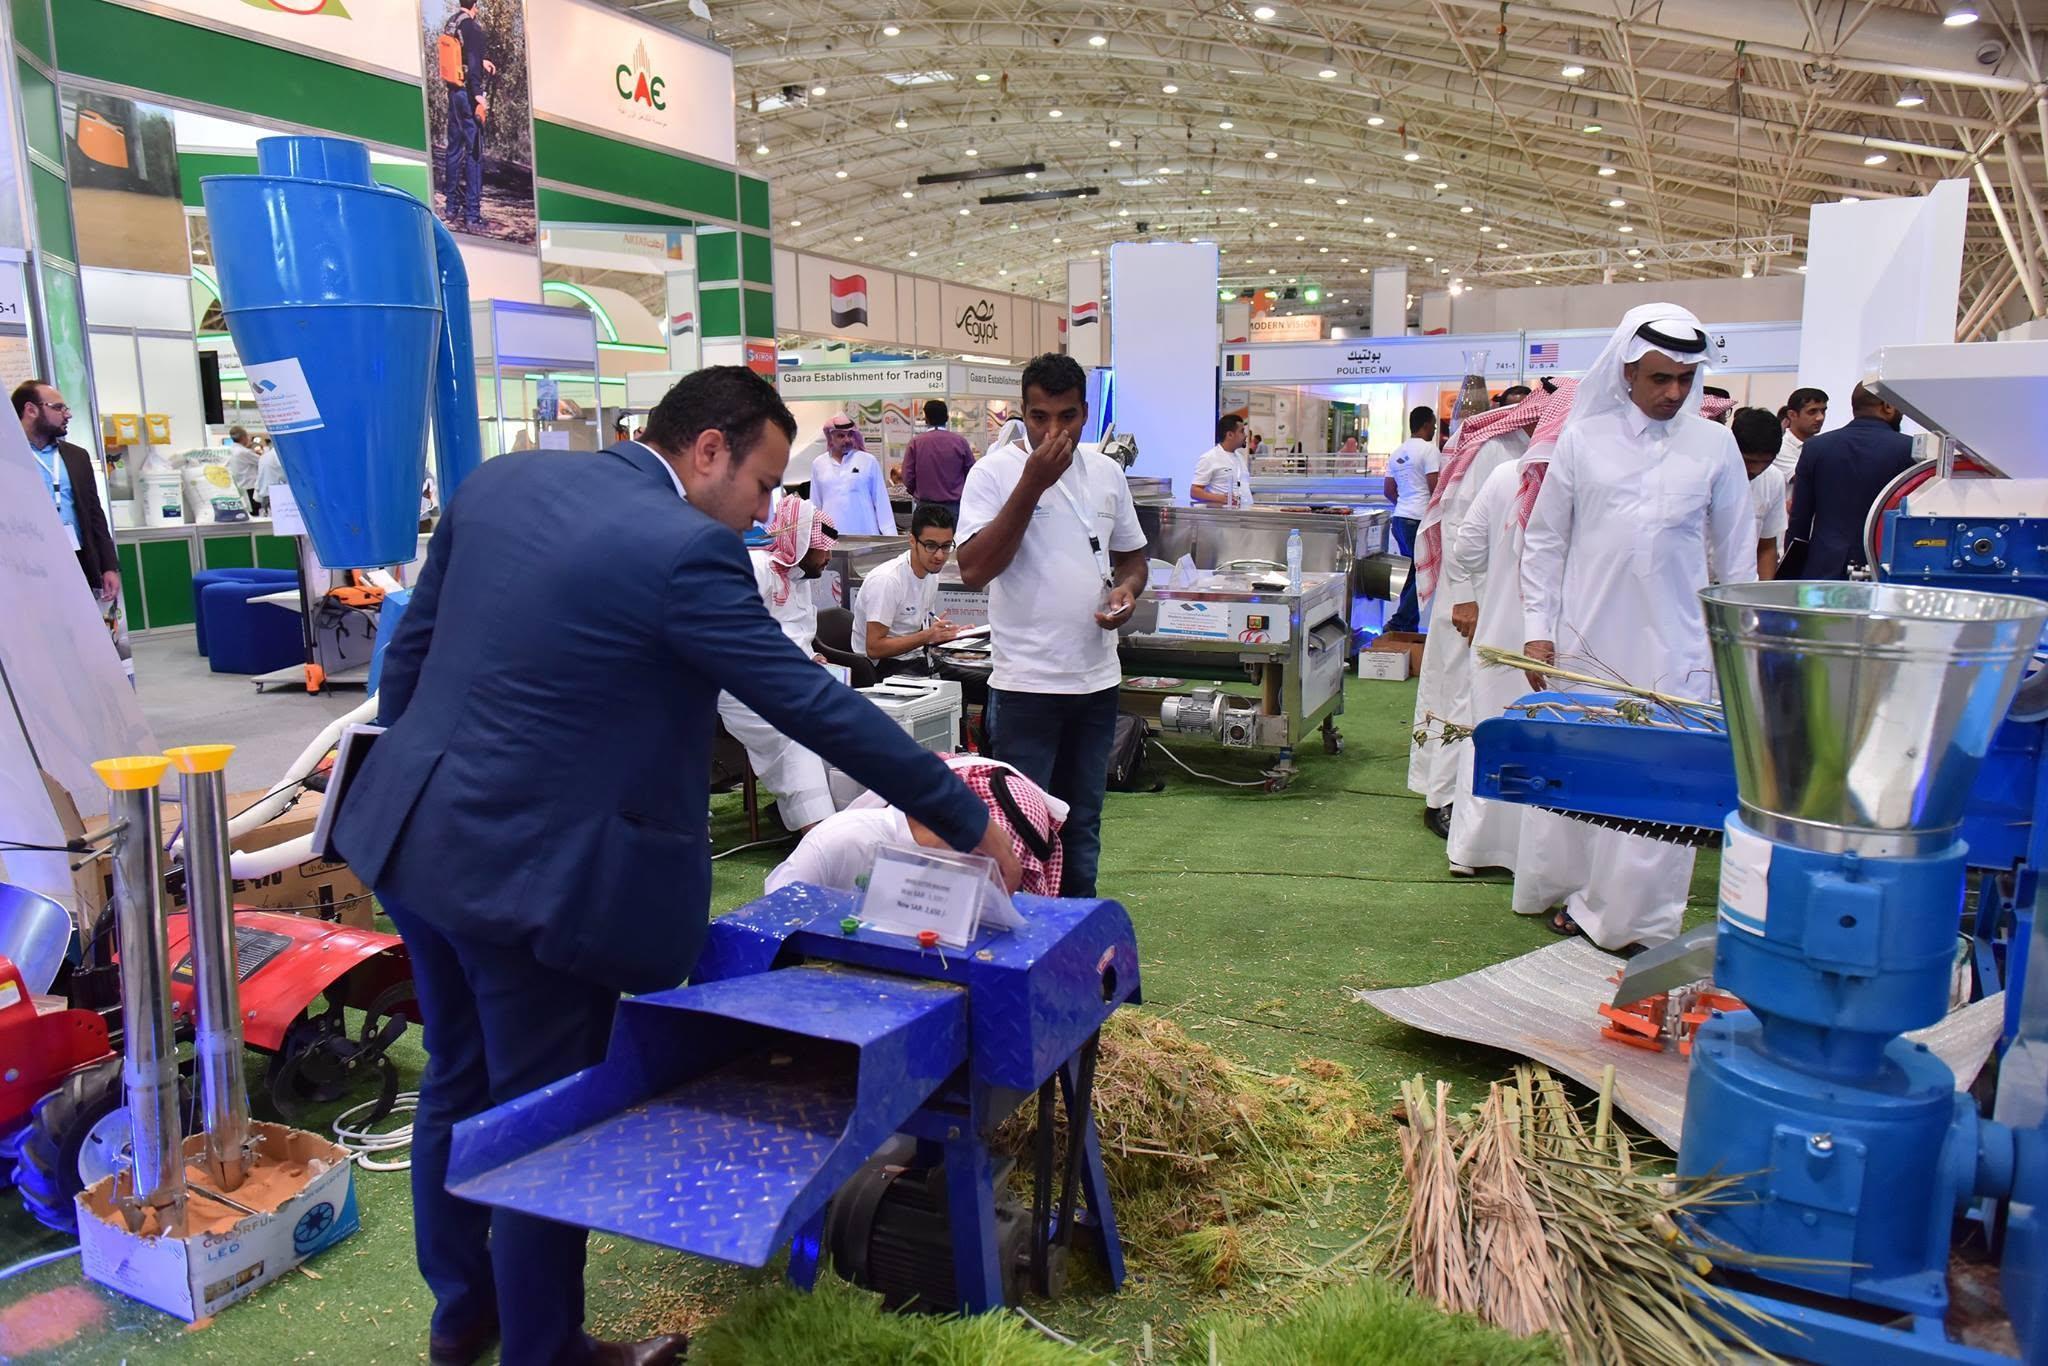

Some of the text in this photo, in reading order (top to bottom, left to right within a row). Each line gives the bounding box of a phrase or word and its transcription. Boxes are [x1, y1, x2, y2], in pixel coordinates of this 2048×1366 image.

[616, 64, 666, 111] CAE
[965, 314, 998, 344] Egypt
[1286, 320, 1317, 328] VISION
[1347, 349, 1381, 364] بولتيك
[783, 369, 943, 383] Gaara Establishment for Trading
[970, 372, 987, 383] Gaara
[1337, 366, 1391, 375] POULTEC NV
[208, 1243, 240, 1262] LED
